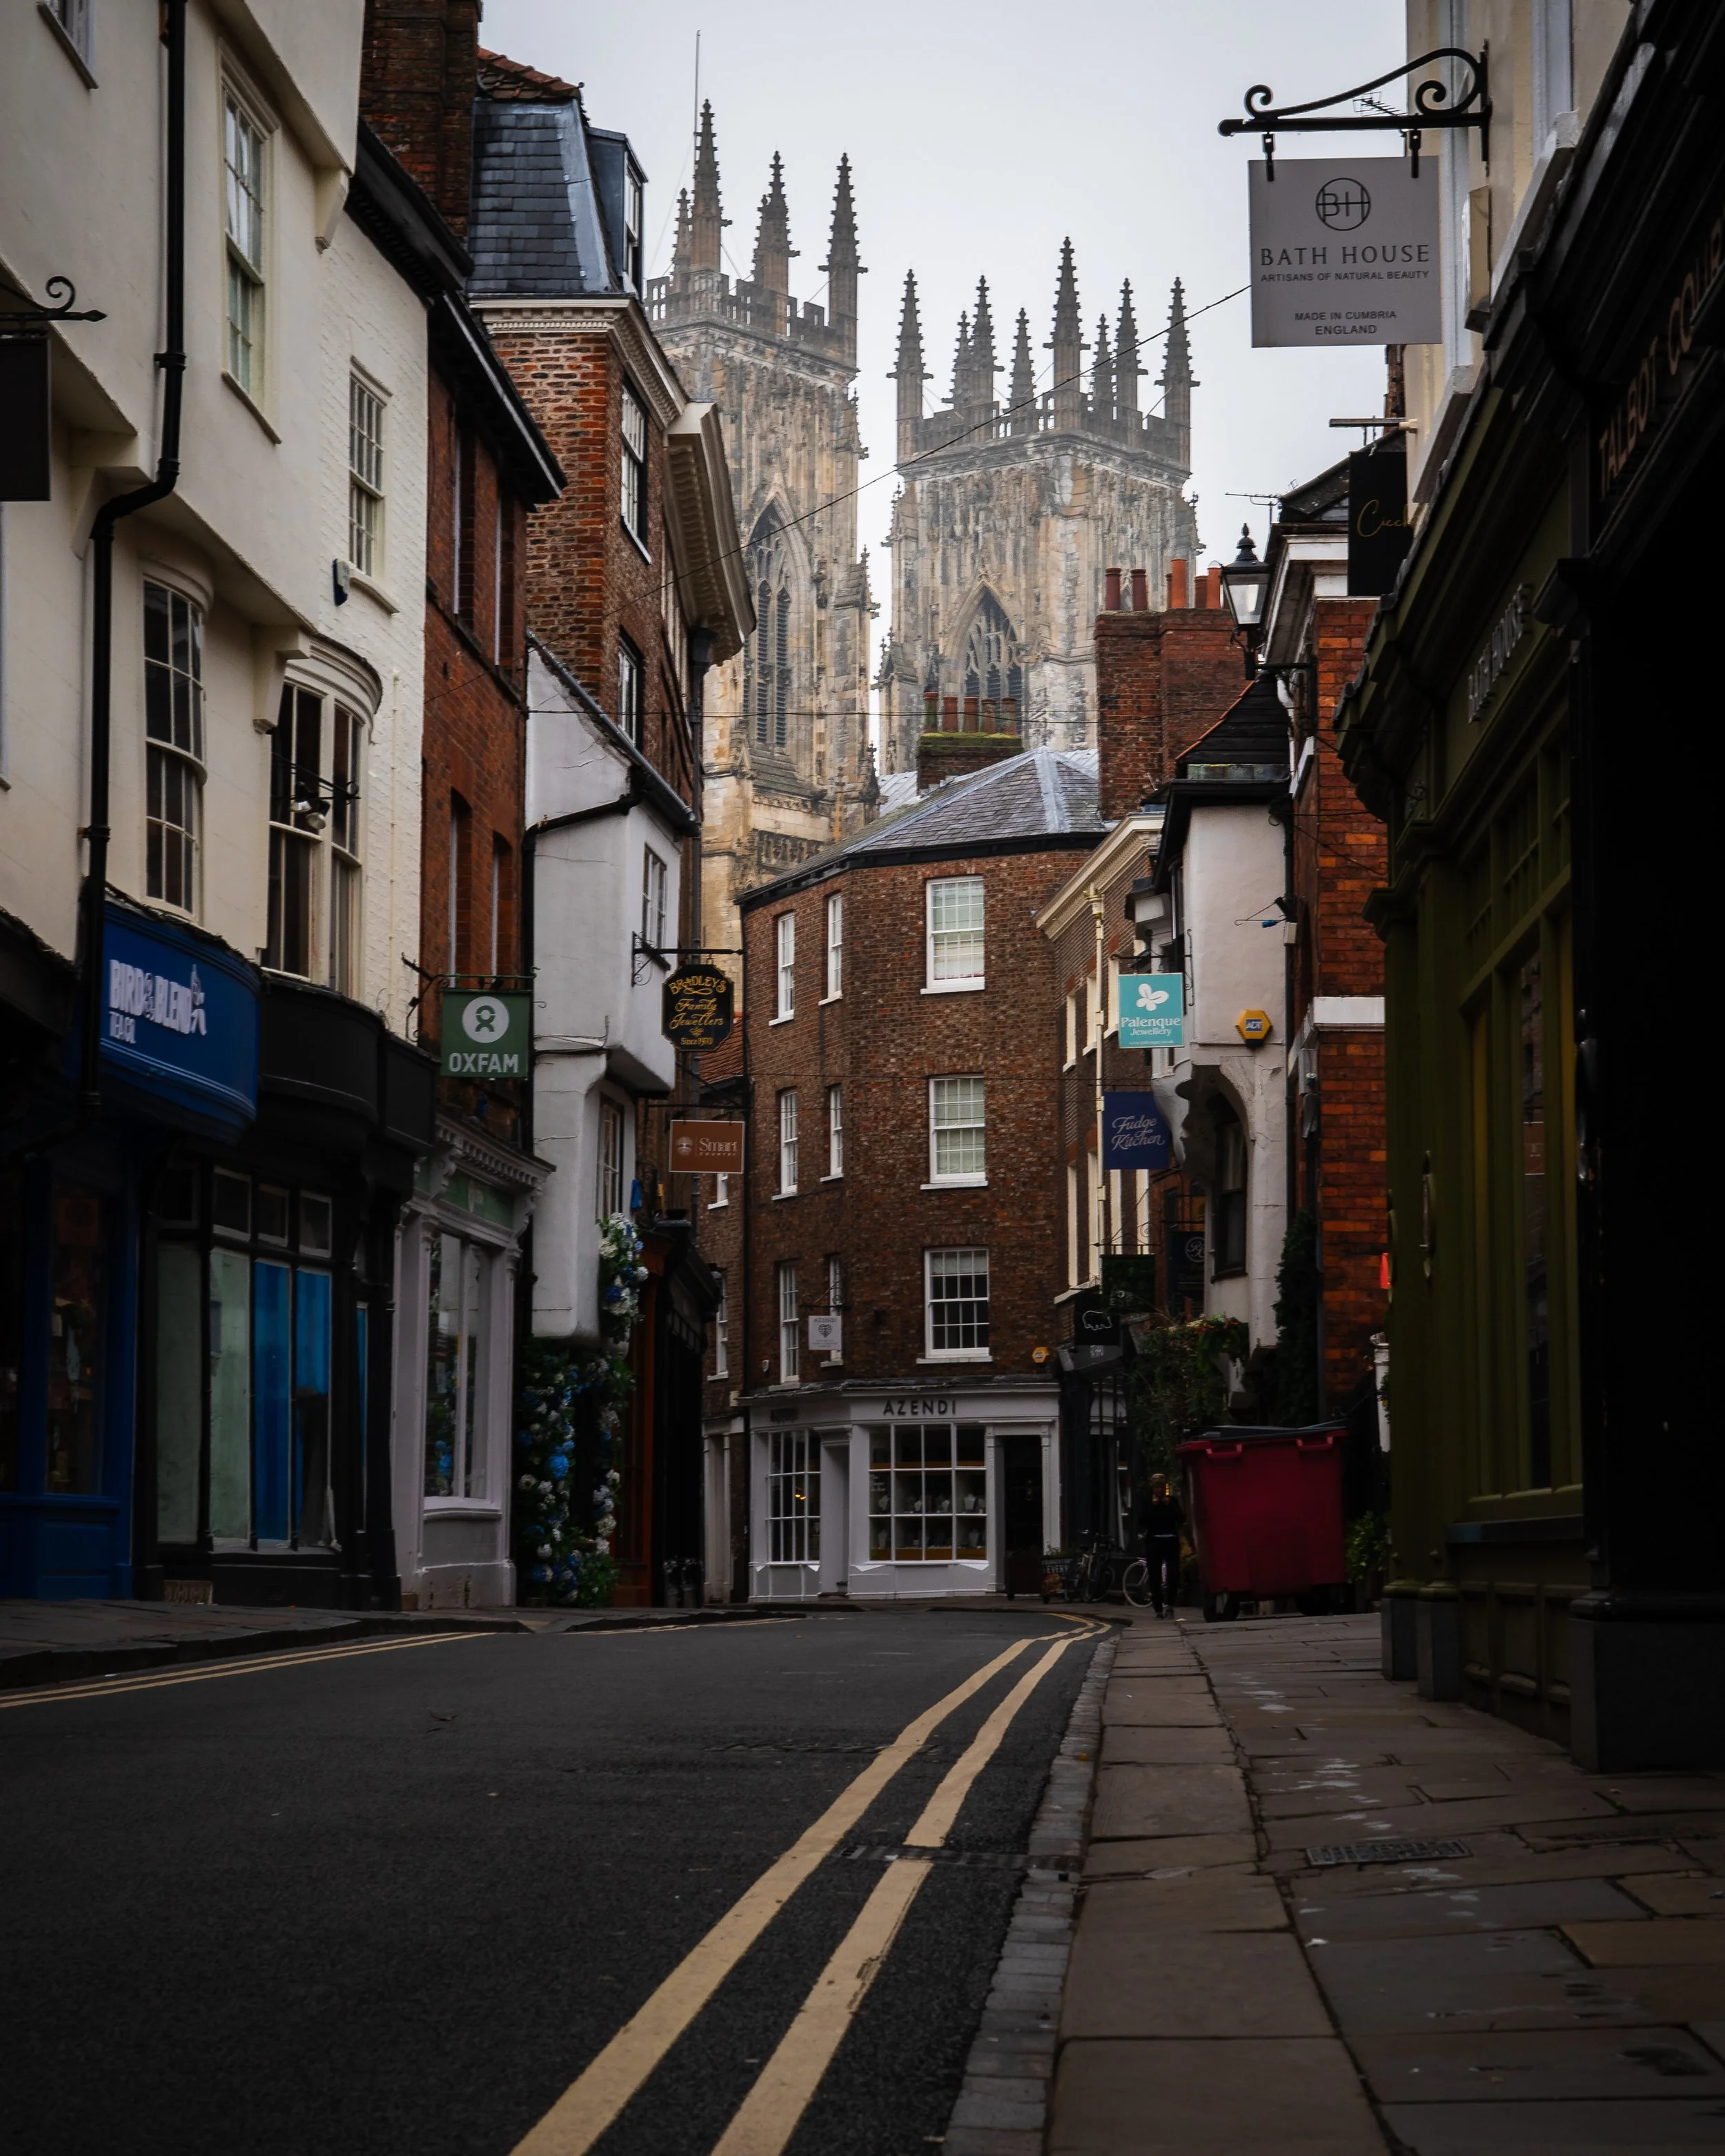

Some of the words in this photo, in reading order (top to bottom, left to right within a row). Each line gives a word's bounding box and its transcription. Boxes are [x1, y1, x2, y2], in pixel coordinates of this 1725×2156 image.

[1260, 247, 1327, 266] BATH
[1342, 244, 1430, 264] HOUSE
[1260, 273, 1314, 282] ARTISANS
[1317, 272, 1332, 281] OF
[1334, 271, 1384, 281] NATURAL
[1387, 270, 1430, 279] BEAUTY
[1294, 311, 1327, 321] MADE
[1330, 311, 1342, 320] IN
[1345, 310, 1397, 319] CUMBRIA
[1314, 325, 1378, 335] ENGLAND
[1597, 335, 1659, 502] TALBOT
[1668, 207, 1725, 377] COUR
[109, 959, 144, 1016] BIRD
[154, 975, 193, 1035] BLEND
[674, 998, 718, 1013] Family
[669, 1011, 724, 1030] Jewellers
[1120, 1017, 1182, 1029] Palenque
[1130, 1028, 1172, 1036] Jewellery
[448, 1052, 520, 1075] OXFAM
[1112, 1115, 1158, 1134] Fudge
[698, 1137, 739, 1151] Smart
[1111, 1129, 1166, 1151] Kitchen
[883, 1400, 957, 1416] AZENDI
